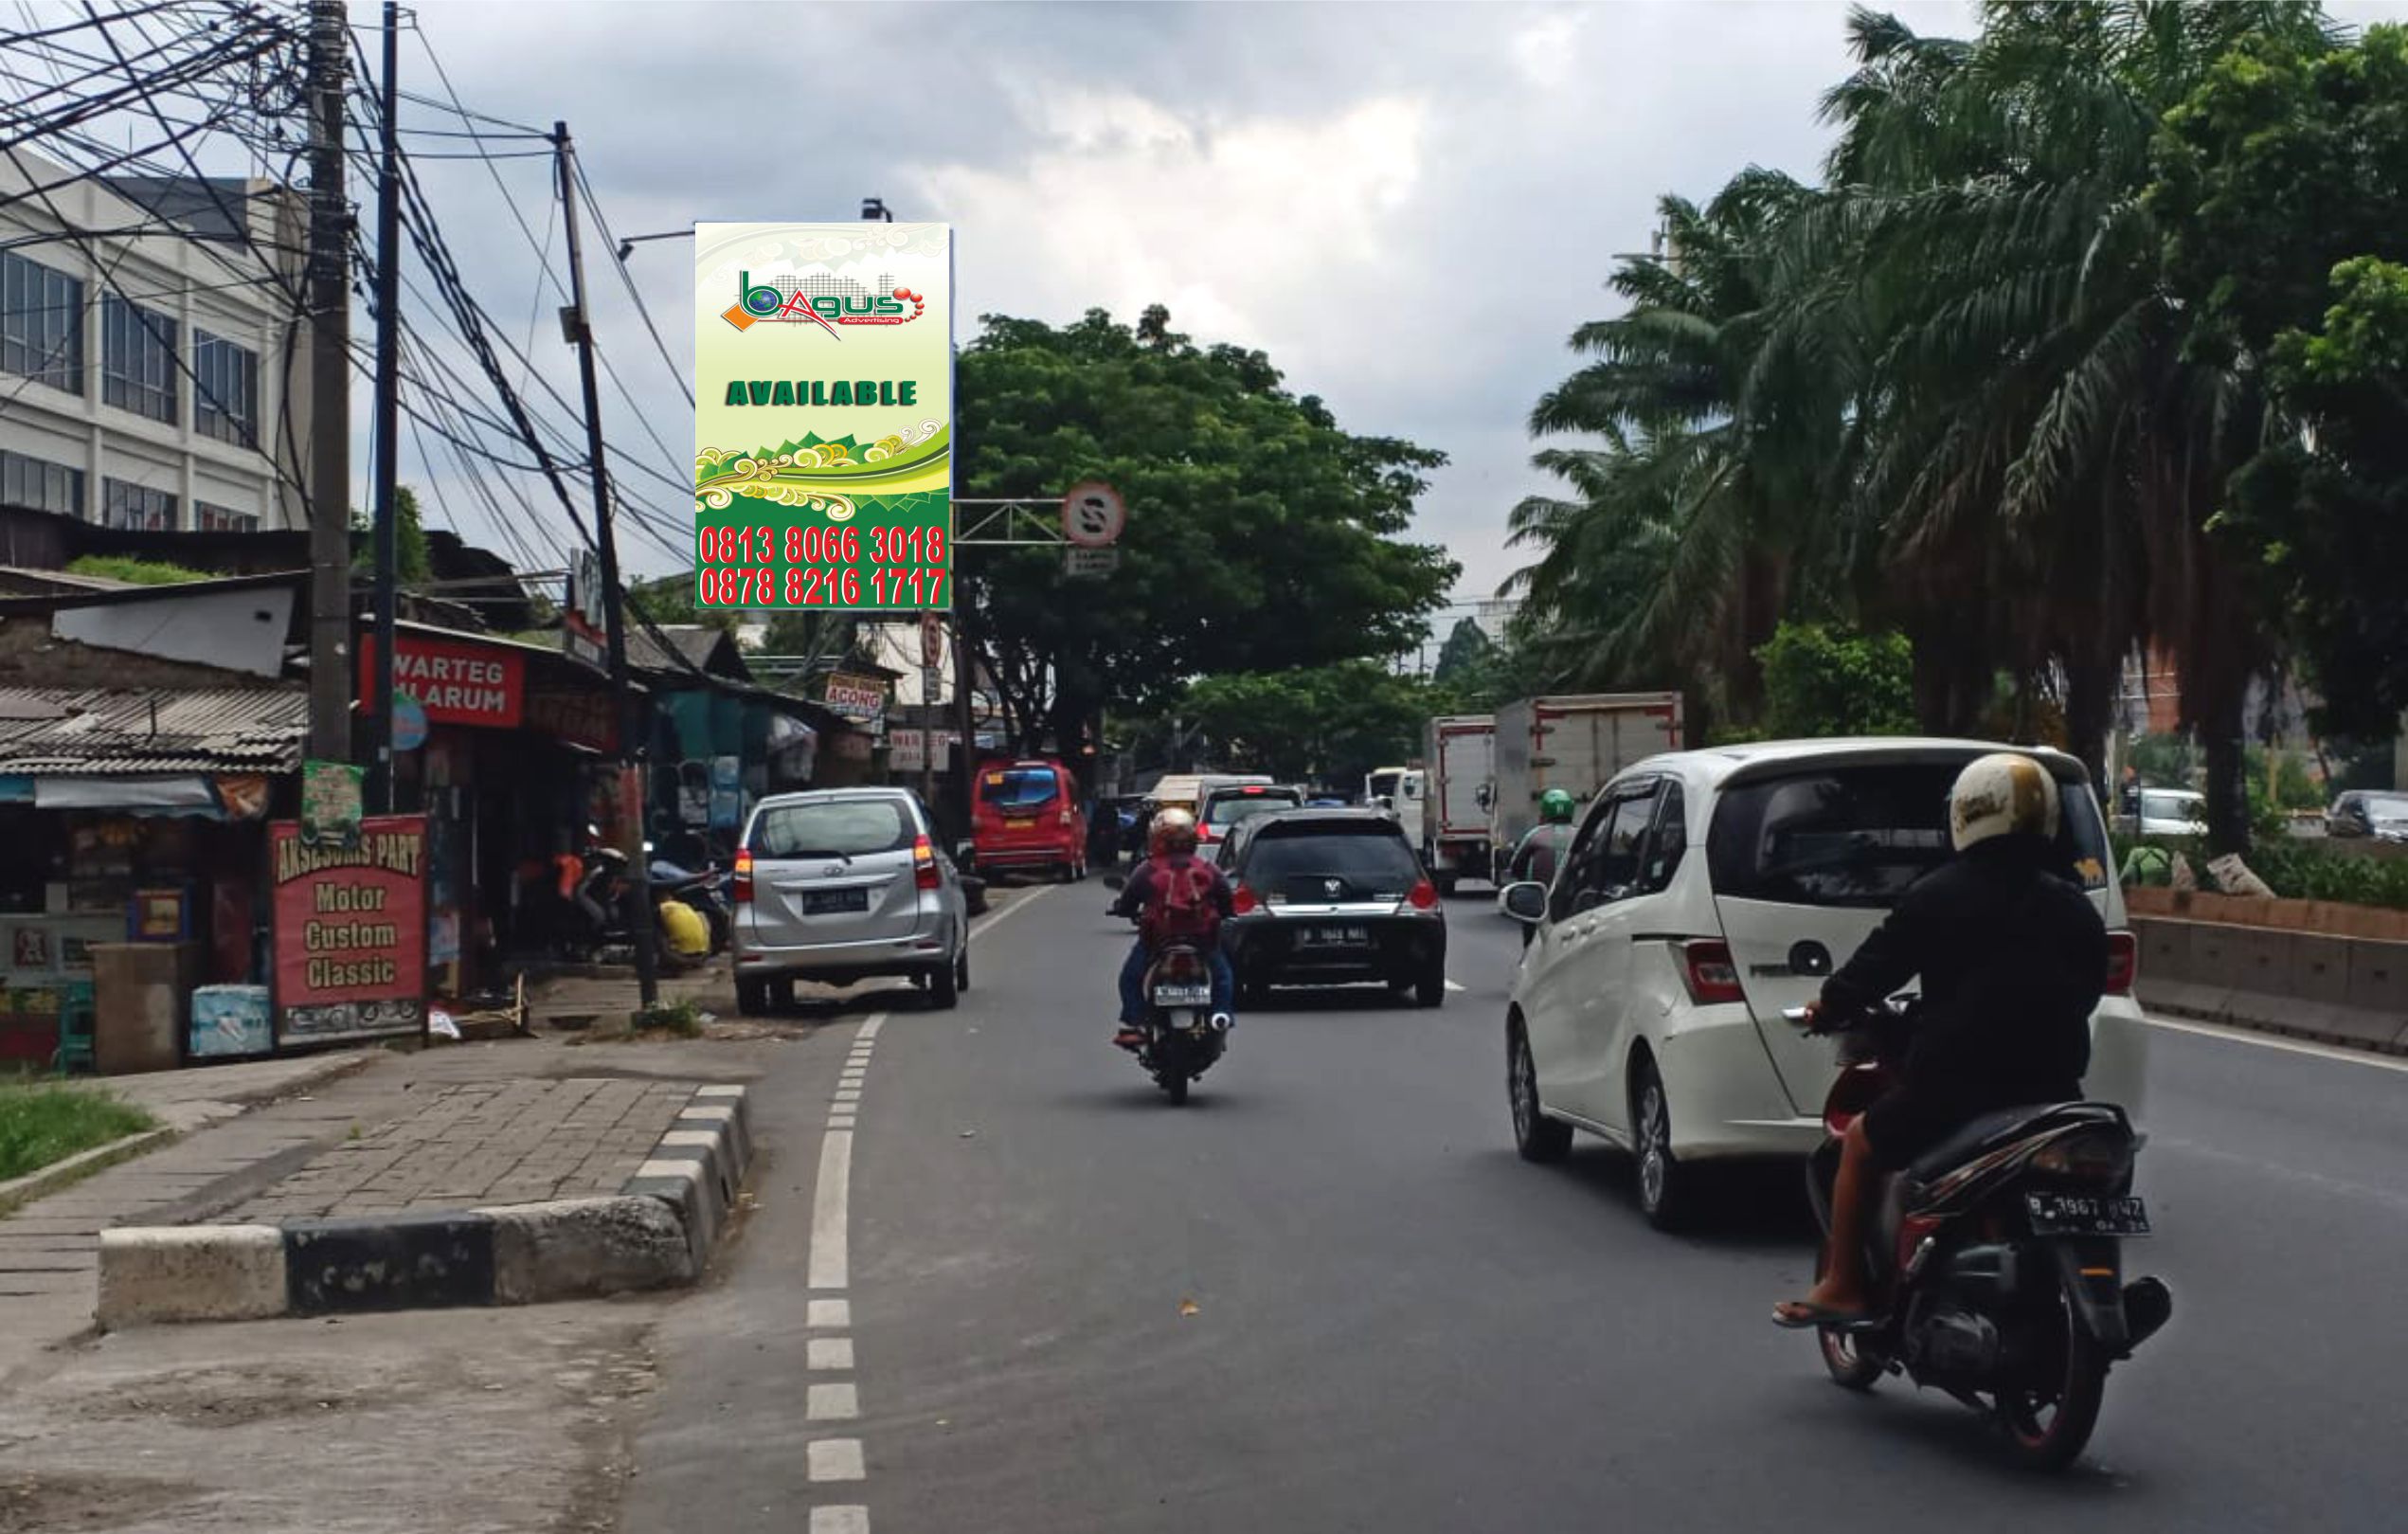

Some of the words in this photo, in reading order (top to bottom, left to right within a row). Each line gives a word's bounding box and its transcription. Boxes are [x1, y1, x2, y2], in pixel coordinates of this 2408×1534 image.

[727, 380, 917, 406] AVAILABLE
[700, 526, 775, 564] 0813
[784, 526, 860, 564] 8066
[870, 526, 945, 564] 3018
[700, 568, 776, 605] 0878
[784, 568, 860, 605] 8216
[871, 568, 945, 605] 1717
[391, 653, 504, 684] WARTEG
[377, 833, 420, 875] PART
[315, 883, 385, 912] Motor
[306, 921, 396, 951] Custom
[309, 957, 394, 987] Classic
